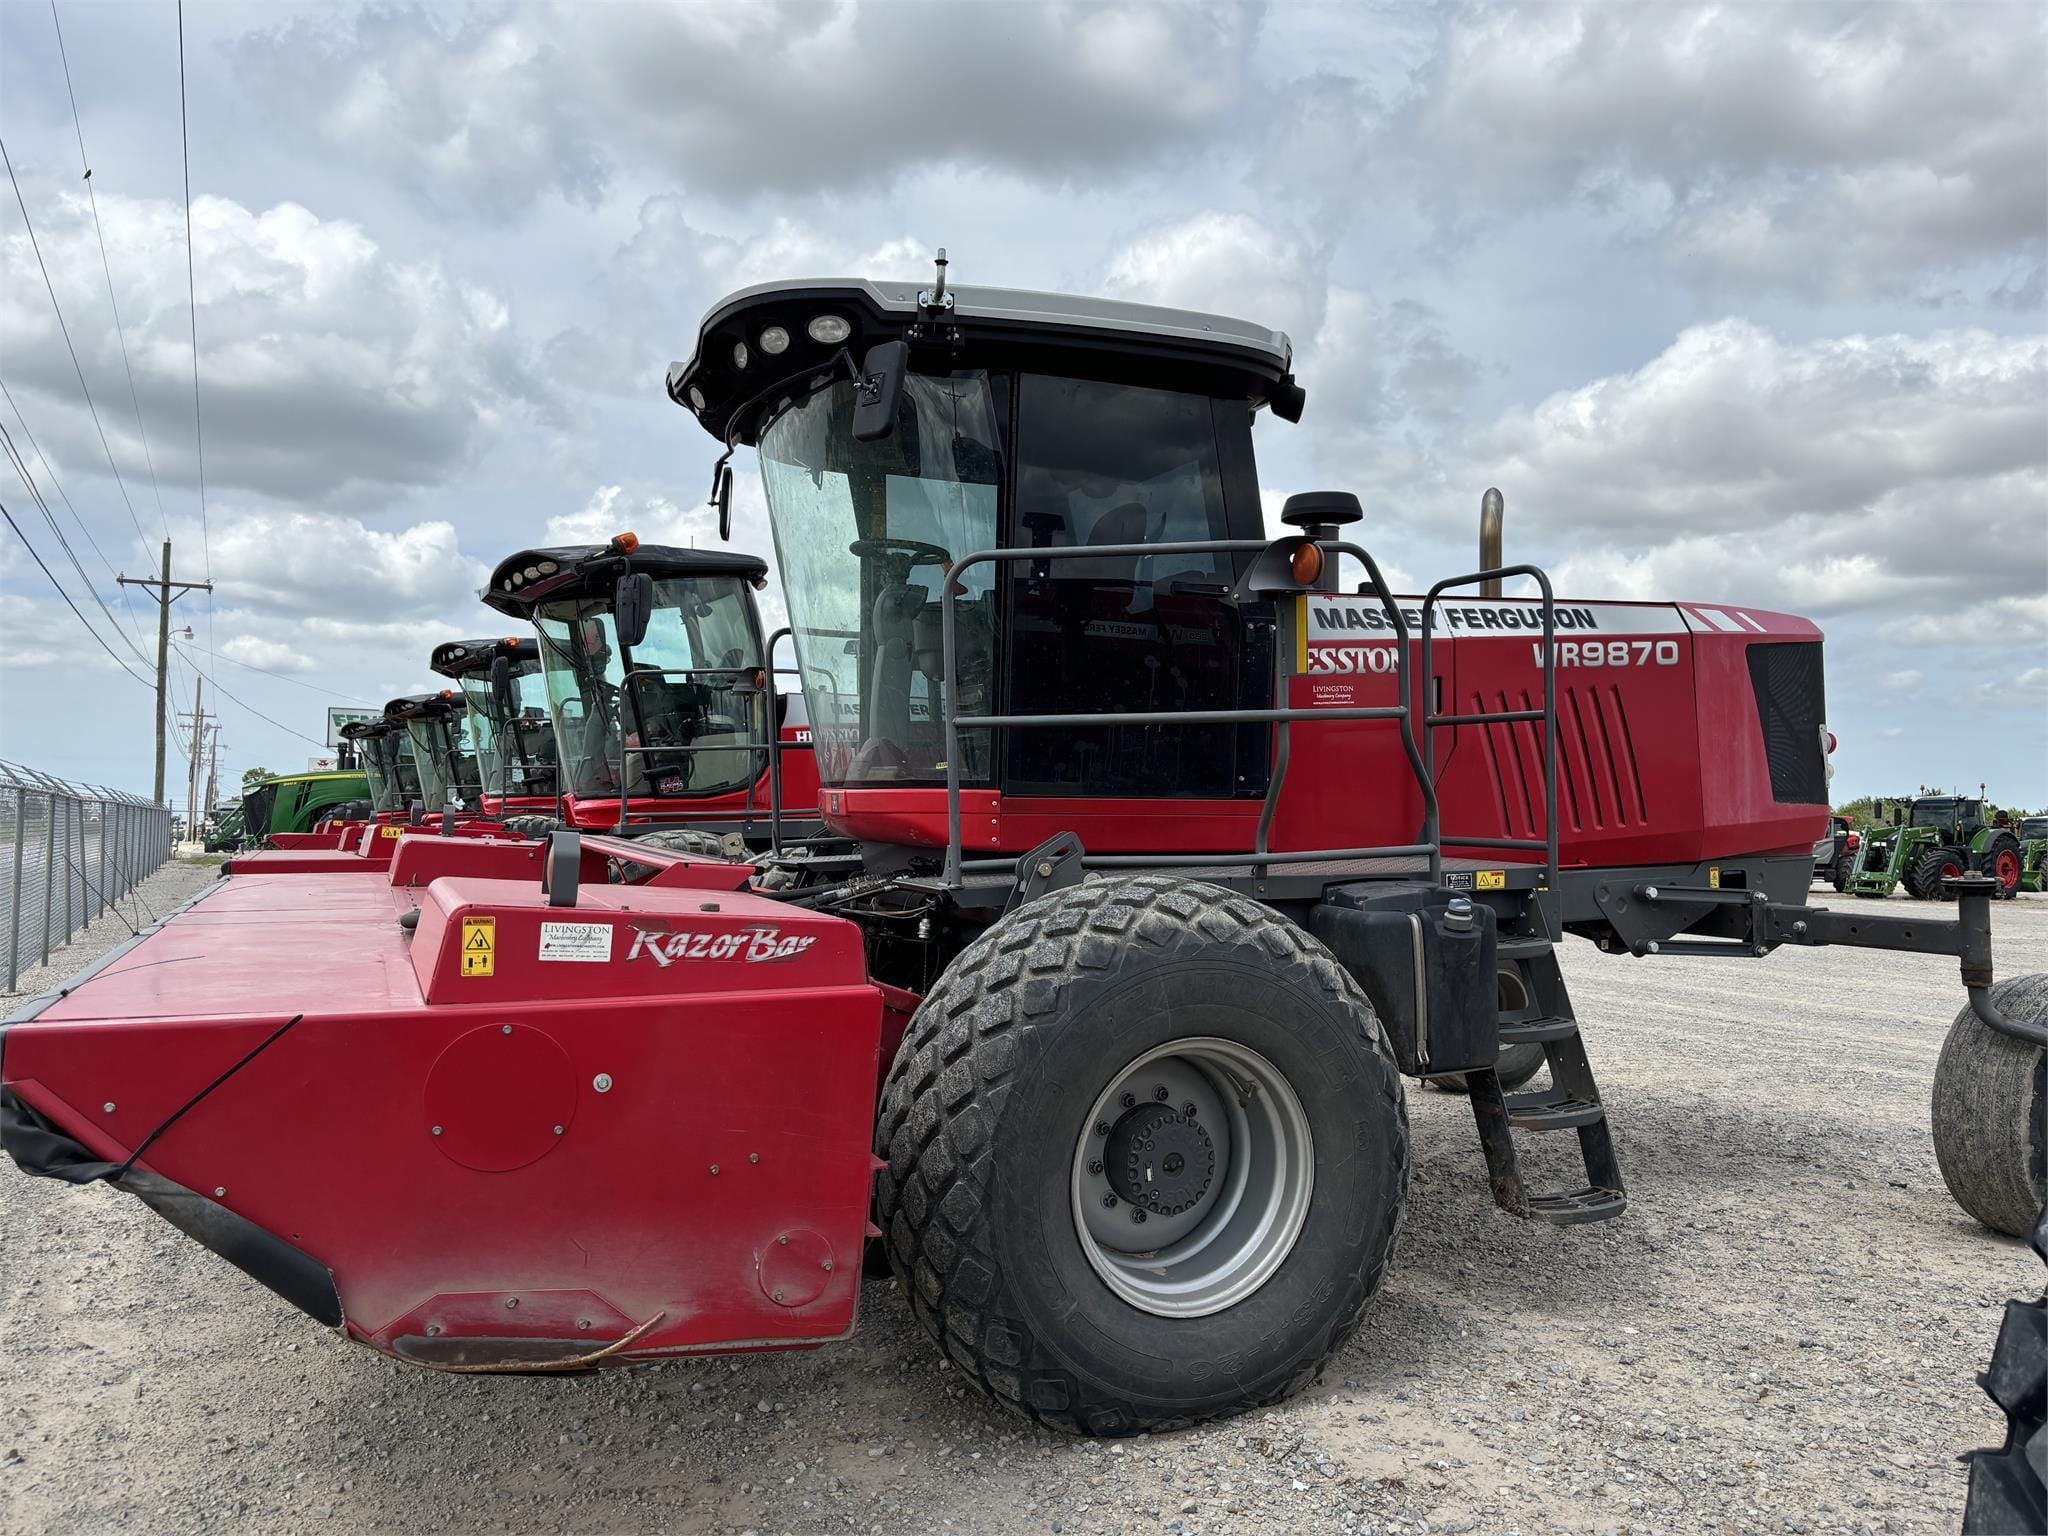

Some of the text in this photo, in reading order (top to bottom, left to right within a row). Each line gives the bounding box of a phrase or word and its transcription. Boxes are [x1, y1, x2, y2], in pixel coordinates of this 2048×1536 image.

[1445, 608, 1598, 629] FERGUSON
[1308, 648, 1398, 675] ESSTO
[1532, 641, 1679, 668] WR9870
[1313, 685, 1354, 693] LIVINGSTON
[544, 924, 610, 935] LIVINGSTON
